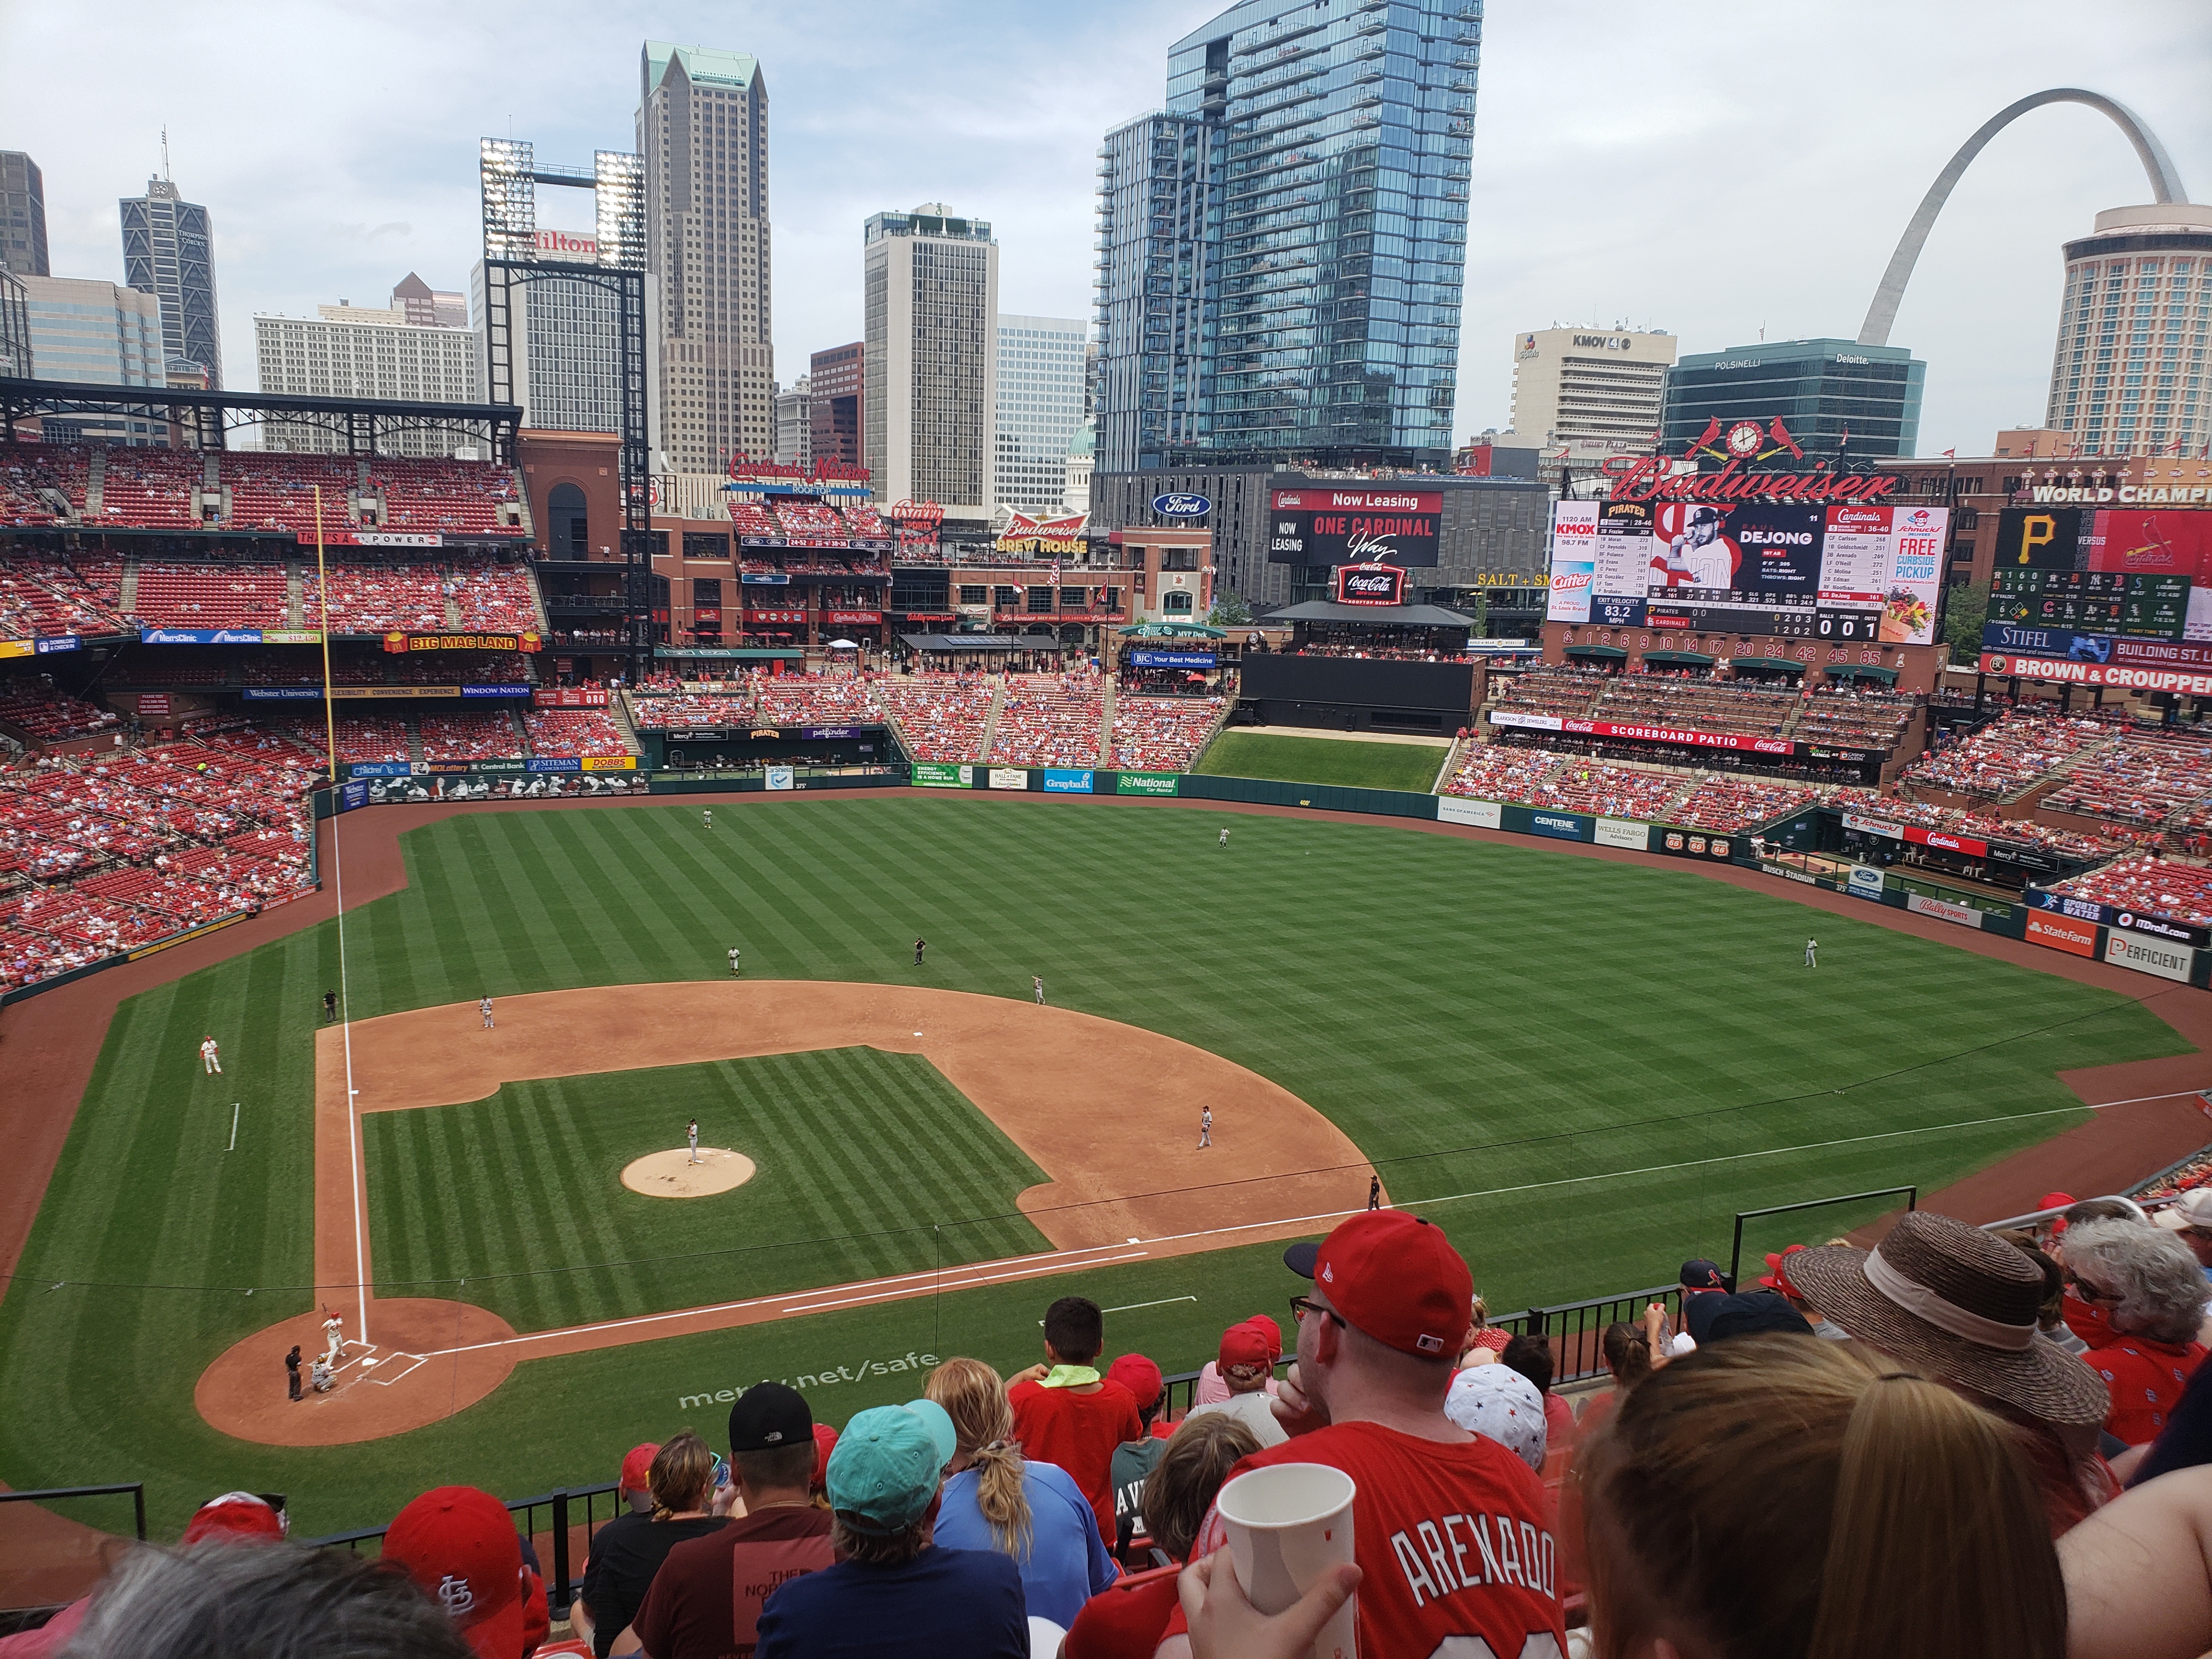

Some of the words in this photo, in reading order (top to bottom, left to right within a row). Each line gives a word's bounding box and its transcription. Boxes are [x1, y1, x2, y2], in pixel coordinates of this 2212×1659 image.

[1573, 335, 1606, 347] KMOV
[1611, 338, 1618, 347] 4
[1715, 359, 1760, 370] POLSINELLI
[729, 453, 806, 481] Cardinals
[805, 455, 871, 484] Nation
[1602, 456, 1899, 501] Budweiser
[792, 486, 831, 494] ROOFTOP
[2033, 486, 2113, 503] WORLD
[1165, 495, 1200, 512] Ford
[1278, 492, 1301, 507] Cardinals
[1333, 493, 1363, 506] Now
[1366, 494, 1418, 510] Leasing
[891, 499, 945, 526] Bally
[1609, 504, 1645, 517] PIRATES
[1838, 508, 1881, 523] Cardinals
[903, 521, 932, 531] SPORTS
[1004, 520, 1085, 537] Budweiser
[1279, 522, 1296, 535] NOW
[1314, 517, 1346, 534] ONE
[1352, 517, 1433, 536] CARDINAL
[1556, 524, 1596, 534] KMOX
[342, 534, 349, 543] A
[1272, 538, 1302, 552] LEASING
[1347, 528, 1397, 561] Way
[1740, 531, 1813, 544] DEJONG
[2018, 514, 2056, 564] P
[2078, 535, 2106, 545] VERSUS
[996, 539, 1036, 552] BREW
[1040, 540, 1087, 554] HOUSE
[1899, 538, 1937, 556] FREE
[1897, 556, 1936, 566] CURBSIDE
[1896, 566, 1934, 578] PICKUP
[1551, 574, 1592, 590] Cutter
[1605, 606, 1630, 617] 83.2
[1820, 620, 1831, 634] 0
[1842, 621, 1853, 636] 0
[1866, 623, 1875, 637] 1
[410, 637, 439, 651] BIG
[440, 636, 476, 649] MAC
[477, 636, 517, 650] LAND
[2001, 627, 2051, 648] STIFEL
[1587, 632, 1592, 645] 1
[1601, 633, 1610, 646] 2
[1621, 634, 1629, 647] 6
[1640, 635, 1649, 648] 9
[1660, 637, 1674, 651] 10
[1684, 638, 1698, 652] 14
[1709, 640, 1724, 654] 17
[1735, 642, 1753, 656] 20
[1765, 644, 1784, 658] 24
[1796, 646, 1816, 662] 42
[1827, 649, 1848, 664] 45
[1860, 651, 1881, 666] 85
[2117, 644, 2177, 658] BUILDING
[2180, 649, 2200, 661] ST.
[2015, 659, 2086, 680] BROWN
[2089, 670, 2101, 681] &
[281, 690, 319, 698] University
[812, 727, 849, 738] petfinder
[1566, 720, 1594, 732] Coca-Cola
[751, 730, 780, 739] PIRATES
[1611, 725, 1694, 742] SCOREBOARD
[1699, 735, 1738, 747] PATIO
[1754, 740, 1787, 753] Coca-Cola
[430, 764, 468, 772] MOLottery
[1133, 777, 1175, 788] National
[1534, 816, 1575, 829] CENTENE
[1553, 825, 1579, 834] Corporation
[1860, 819, 1900, 832] Schnucks
[1598, 825, 1621, 834] WELLS
[1622, 828, 1646, 838] FARGO
[1609, 833, 1633, 842] Advisors
[1927, 832, 1959, 849] Cardinals
[1993, 849, 2013, 861] Mercy
[1762, 864, 1784, 877] BUSCH
[1785, 868, 1816, 885] STADIUM
[1858, 871, 1875, 881] Ford
[1920, 899, 1947, 917] Bally
[1946, 909, 1968, 921] SPORTS
[2063, 898, 2101, 913] SPORTS
[2063, 905, 2100, 921] WATER
[2042, 924, 2092, 945] StateFarm
[2135, 918, 2191, 939] ITDroll.com
[2108, 937, 2187, 971] PERFICIENT
[678, 1351, 941, 1409] mer.net/safe
[1390, 1513, 1557, 1609] ARENADO
